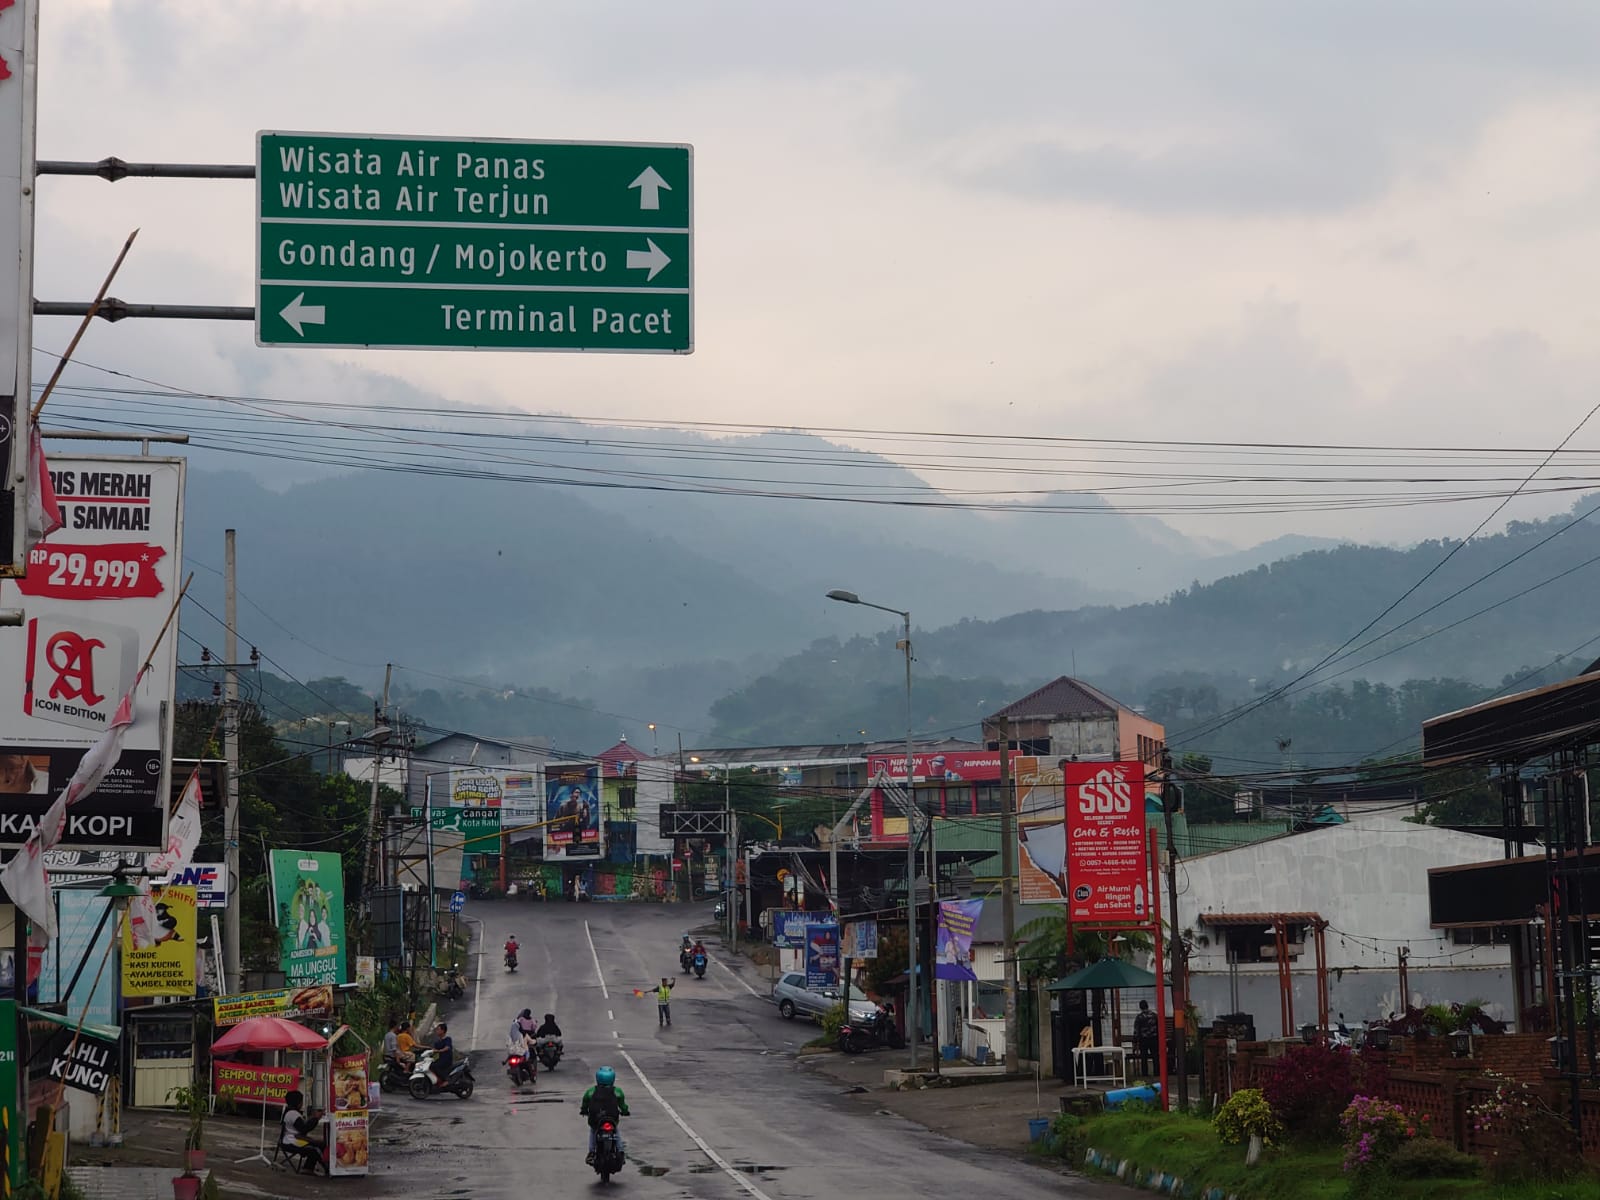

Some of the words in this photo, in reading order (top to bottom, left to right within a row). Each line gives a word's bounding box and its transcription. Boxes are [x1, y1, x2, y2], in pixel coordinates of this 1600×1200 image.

[279, 145, 381, 175] Wisata
[396, 149, 440, 177] Air
[456, 152, 545, 180] Panas
[279, 180, 381, 210] Wisata
[395, 184, 439, 212] Air
[453, 183, 548, 218] Terjun
[278, 239, 415, 275] Gondang
[425, 243, 441, 274] /
[455, 242, 607, 278] Mojokerto
[441, 304, 577, 332] Terminal
[592, 307, 672, 334] Pacet
[80, 472, 151, 497] MERAH
[73, 505, 150, 531] SAMAA!
[35, 698, 61, 713] ICON
[63, 705, 106, 722] EDITION
[0, 813, 45, 834] KA
[68, 815, 133, 837] KOPI
[1099, 827, 1110, 838] &
[1113, 825, 1140, 838] Resto
[1105, 893, 1131, 901] Ringan
[1109, 901, 1131, 909] Sehat
[290, 963, 304, 977] MA
[305, 957, 338, 976] UNGGUL
[165, 979, 194, 987] KOREK
[63, 1040, 109, 1068] AHLI
[49, 1057, 109, 1092] KUNCI
[218, 1069, 257, 1081] SEMPOL
[219, 1084, 251, 1095] AYAM
